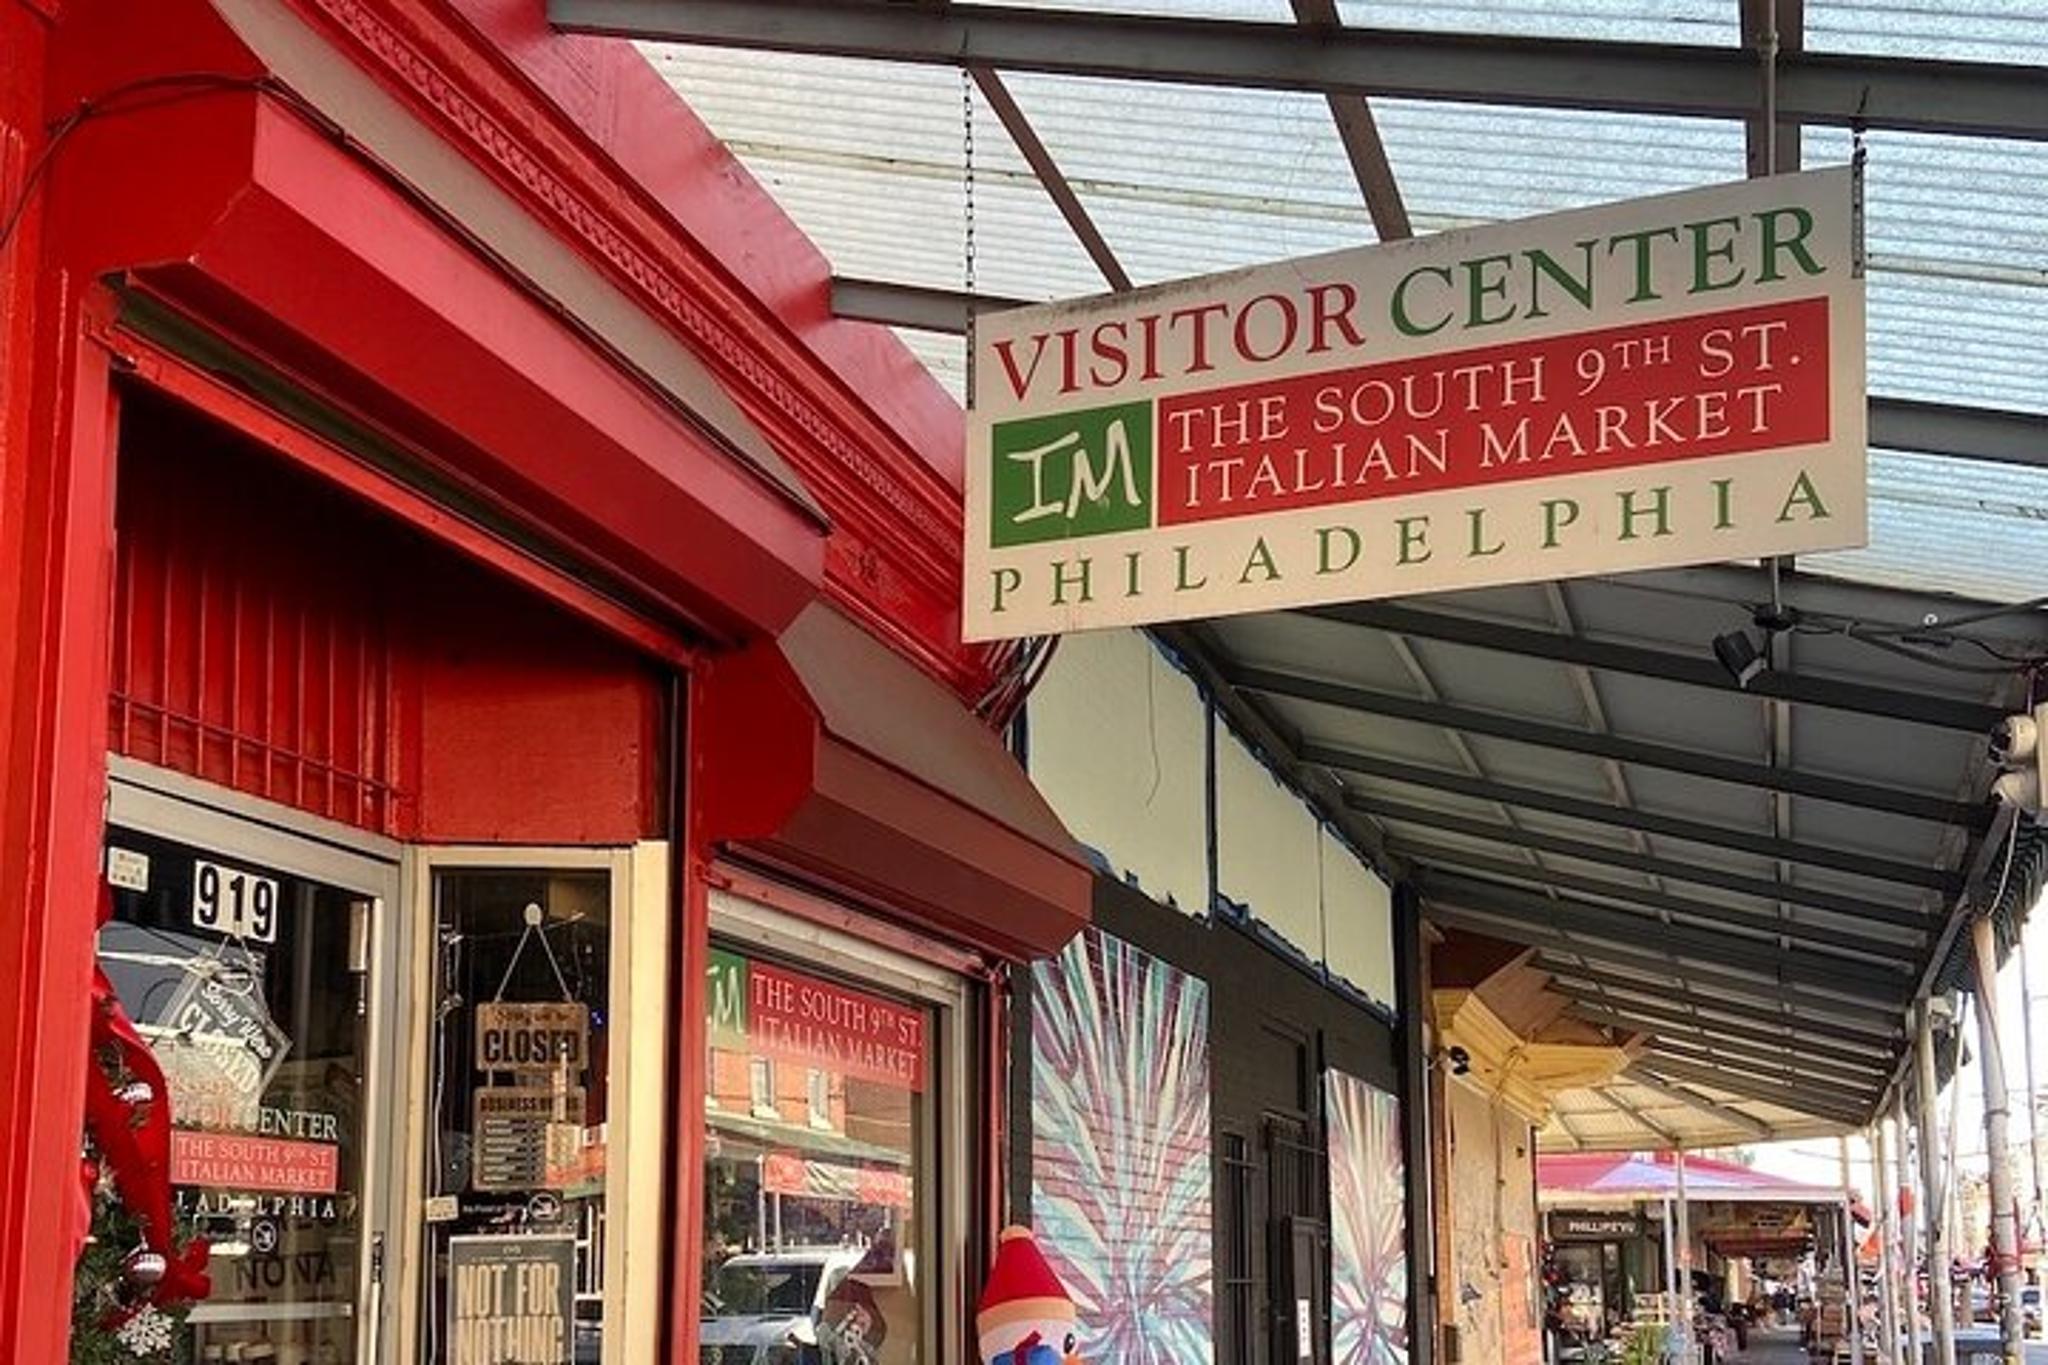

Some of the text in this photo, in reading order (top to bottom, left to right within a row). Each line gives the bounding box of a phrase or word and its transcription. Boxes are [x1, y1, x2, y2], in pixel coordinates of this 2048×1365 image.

[992, 207, 1826, 400] VISITOR CENTER
[1169, 321, 1801, 453] THE SOUTH 9TH ST.
[1008, 419, 1141, 523] IM
[1185, 383, 1782, 507] ITALIAN MARKET
[991, 469, 1830, 612] PHILADELPHIA
[197, 865, 273, 938] 919
[706, 966, 744, 1034] M
[753, 974, 795, 1013] THE
[801, 990, 866, 1032] SOUTH
[484, 1029, 579, 1063] CLOSED
[757, 1015, 917, 1081] ITALIAN MARKET
[178, 1137, 214, 1158] THE
[219, 1143, 277, 1164] SOUTH
[180, 1160, 328, 1187] ITALIAN MARKET
[457, 1262, 559, 1317] NOT FOR
[456, 1316, 564, 1365] NOTHING
